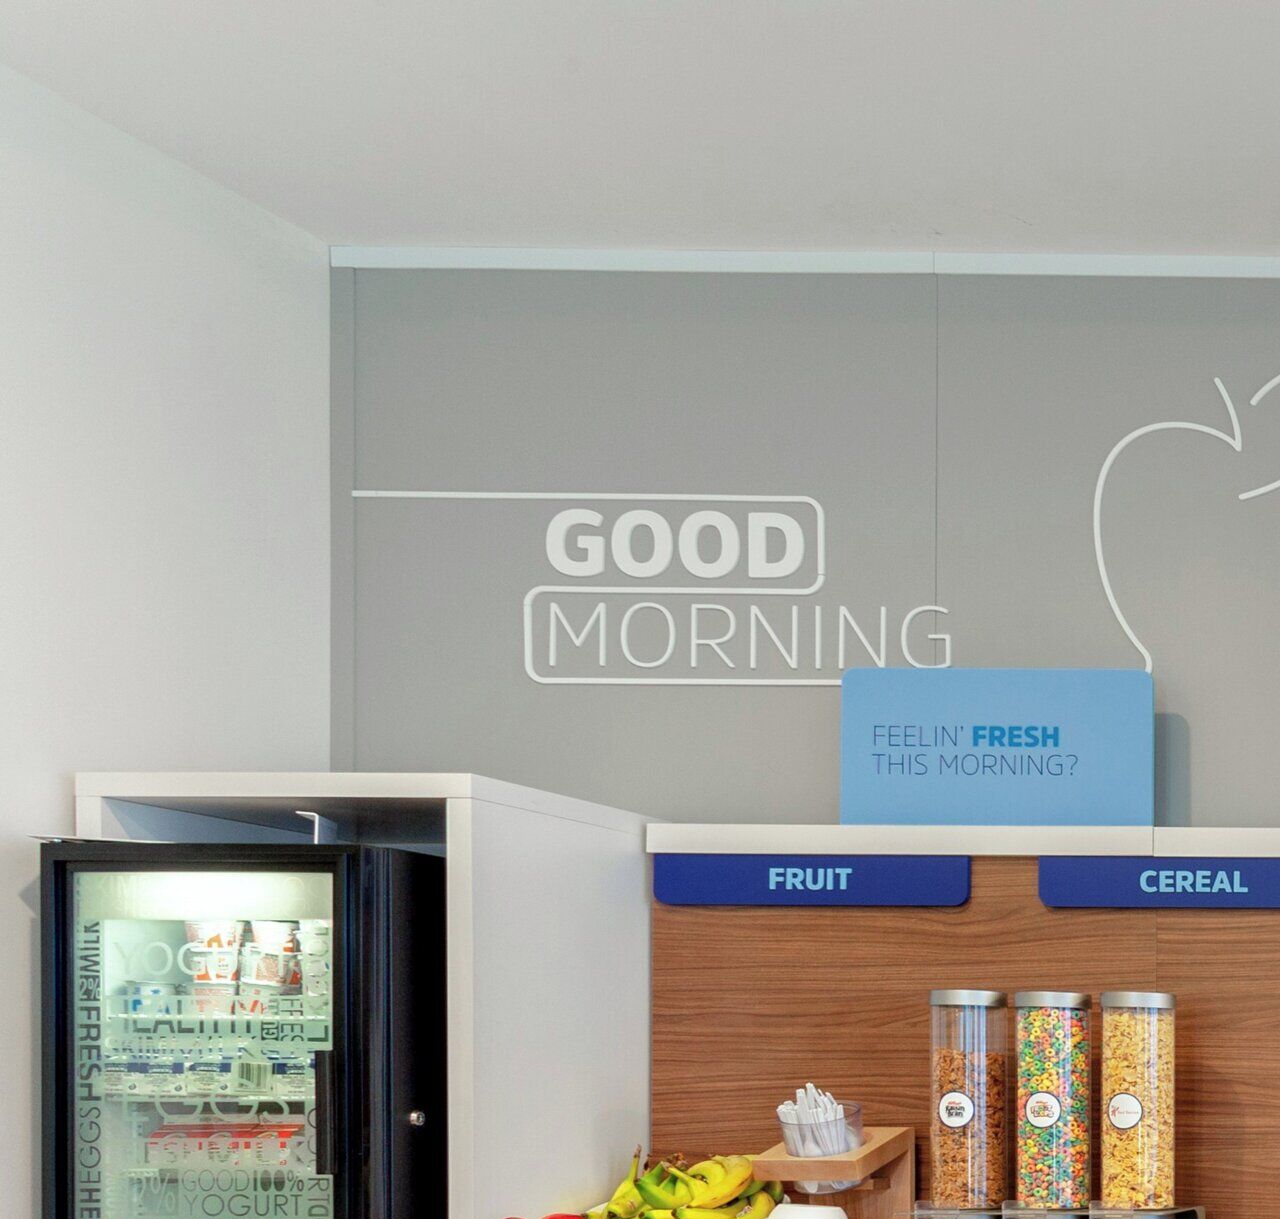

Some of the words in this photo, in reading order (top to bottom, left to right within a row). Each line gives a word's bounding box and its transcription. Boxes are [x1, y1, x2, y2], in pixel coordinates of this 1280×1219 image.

[546, 508, 805, 579] GOOD
[549, 602, 953, 669] MORNING
[972, 726, 1060, 748] FRESH
[872, 753, 929, 776] THIS
[938, 753, 1079, 776] MORNING?
[768, 867, 852, 891] FRUIT
[1139, 870, 1249, 894] CEREAL
[80, 1006, 102, 1101] FRESH
[181, 1170, 249, 1192] GOOD
[253, 1170, 304, 1192] 100%
[182, 1194, 302, 1217] YOGURT
